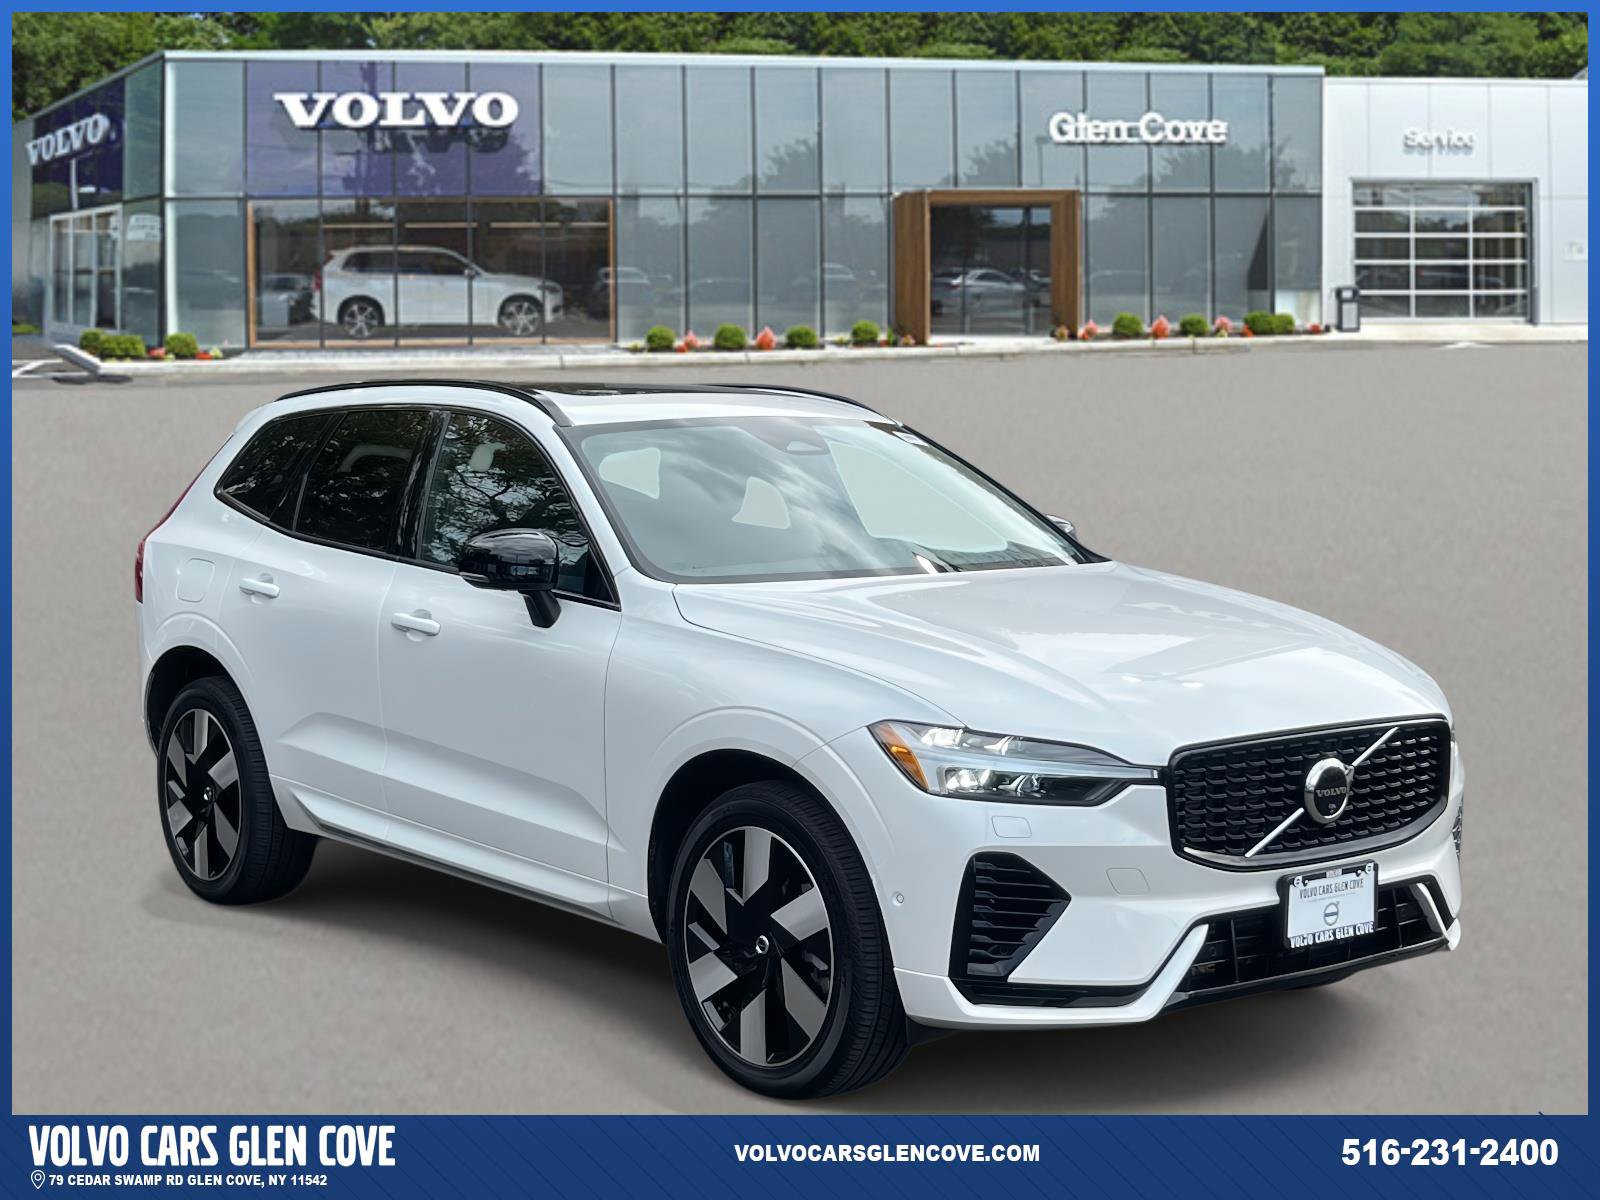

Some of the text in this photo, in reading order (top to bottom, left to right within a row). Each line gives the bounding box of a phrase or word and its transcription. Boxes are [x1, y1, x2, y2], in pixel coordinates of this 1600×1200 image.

[273, 91, 519, 128] VOLVO
[24, 112, 111, 166] VOLVO
[1049, 111, 1228, 143] Glen Cove
[1315, 786, 1347, 798] VOLVO
[1300, 887, 1318, 900] VOLVO
[1318, 884, 1333, 896] CARS
[1334, 881, 1349, 893] GLEN
[1349, 878, 1364, 890] COVE
[1290, 921, 1374, 949] VOLVO CARS GLEN COVE
